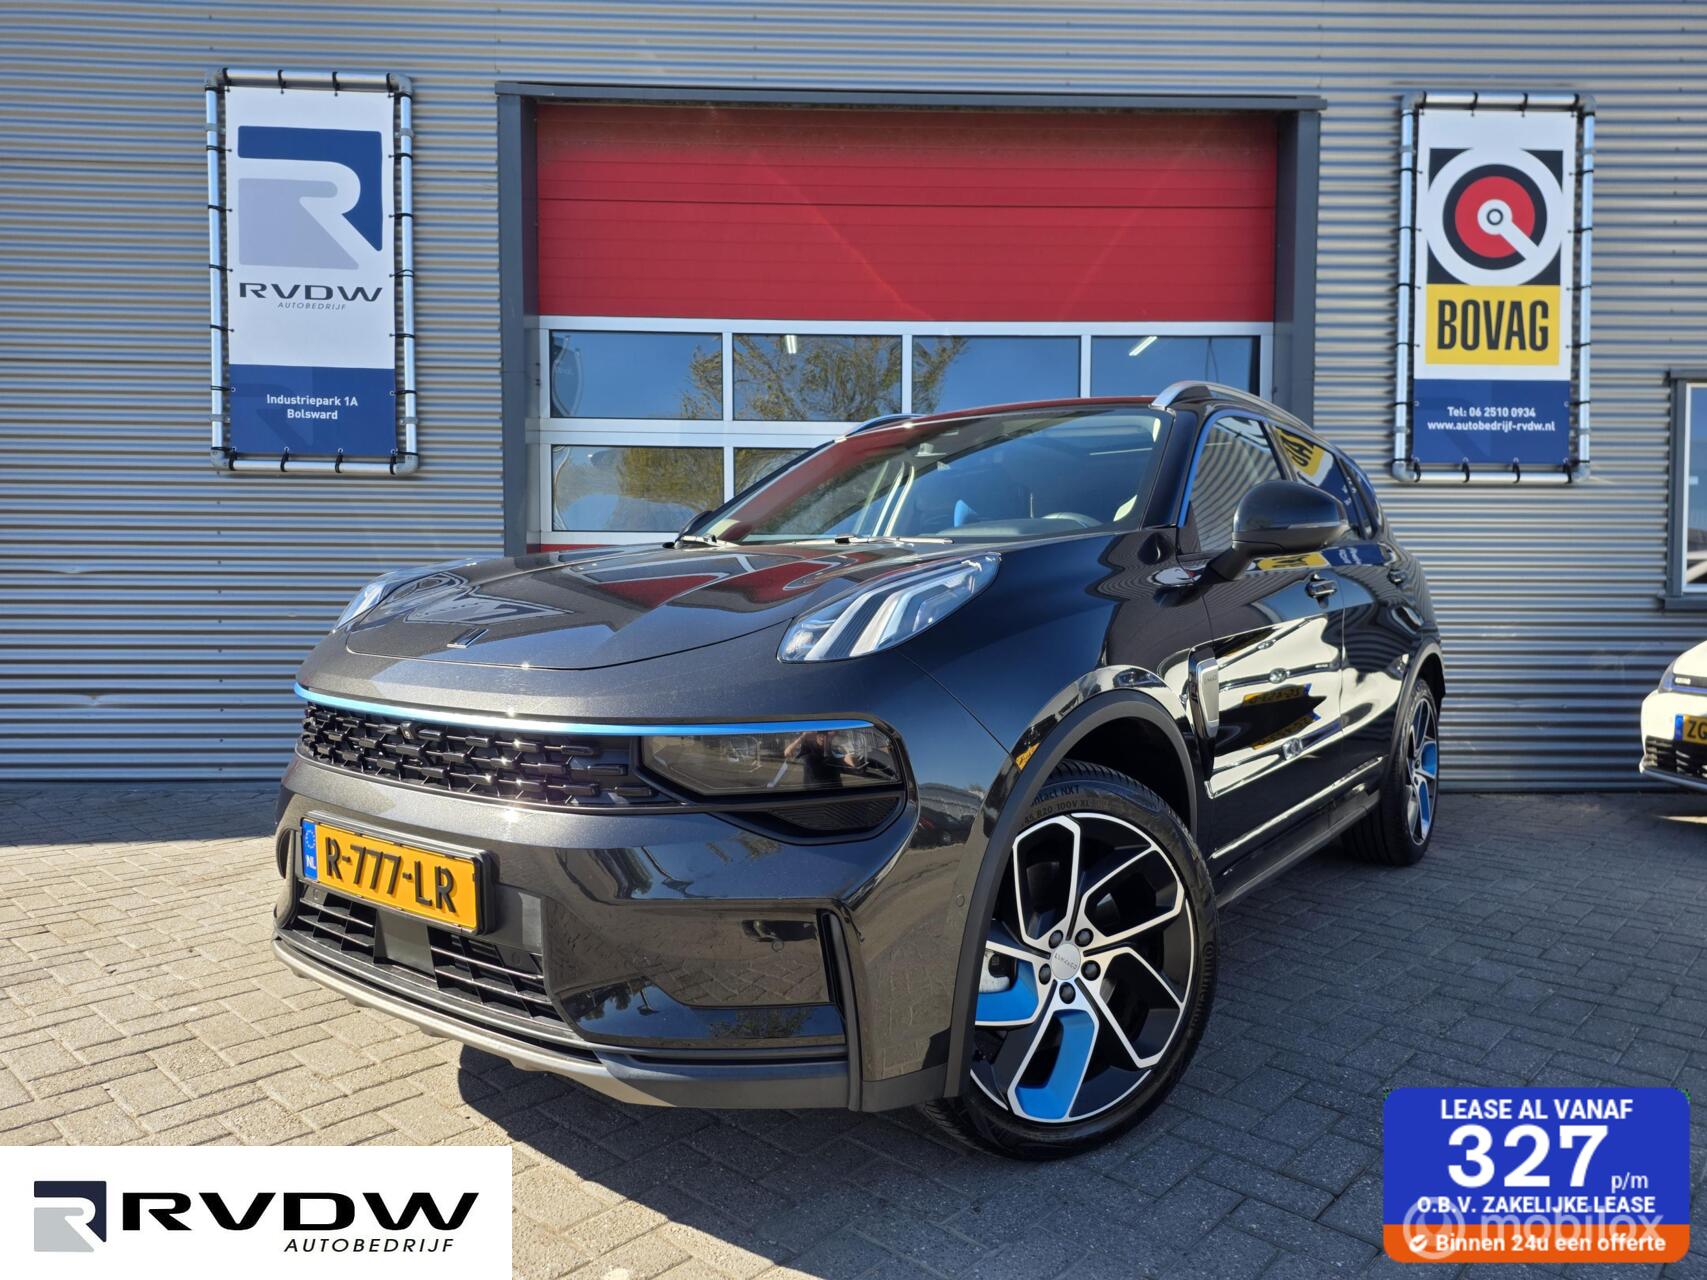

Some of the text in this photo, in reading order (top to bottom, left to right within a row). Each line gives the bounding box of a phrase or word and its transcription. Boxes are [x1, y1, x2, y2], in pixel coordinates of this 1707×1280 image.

[239, 282, 383, 302] RVDW
[277, 301, 347, 311] AUTOBEDRIJF
[1437, 299, 1549, 352] BOVAG
[266, 393, 359, 408] Industriepark 1A
[287, 408, 338, 420] Bolsward
[1447, 406, 1537, 418] Tel: 06 2510 0934
[1427, 421, 1556, 433] www.autobedrijf-rvdw.nl
[305, 854, 317, 869] NL
[325, 836, 457, 914] R-777-LR
